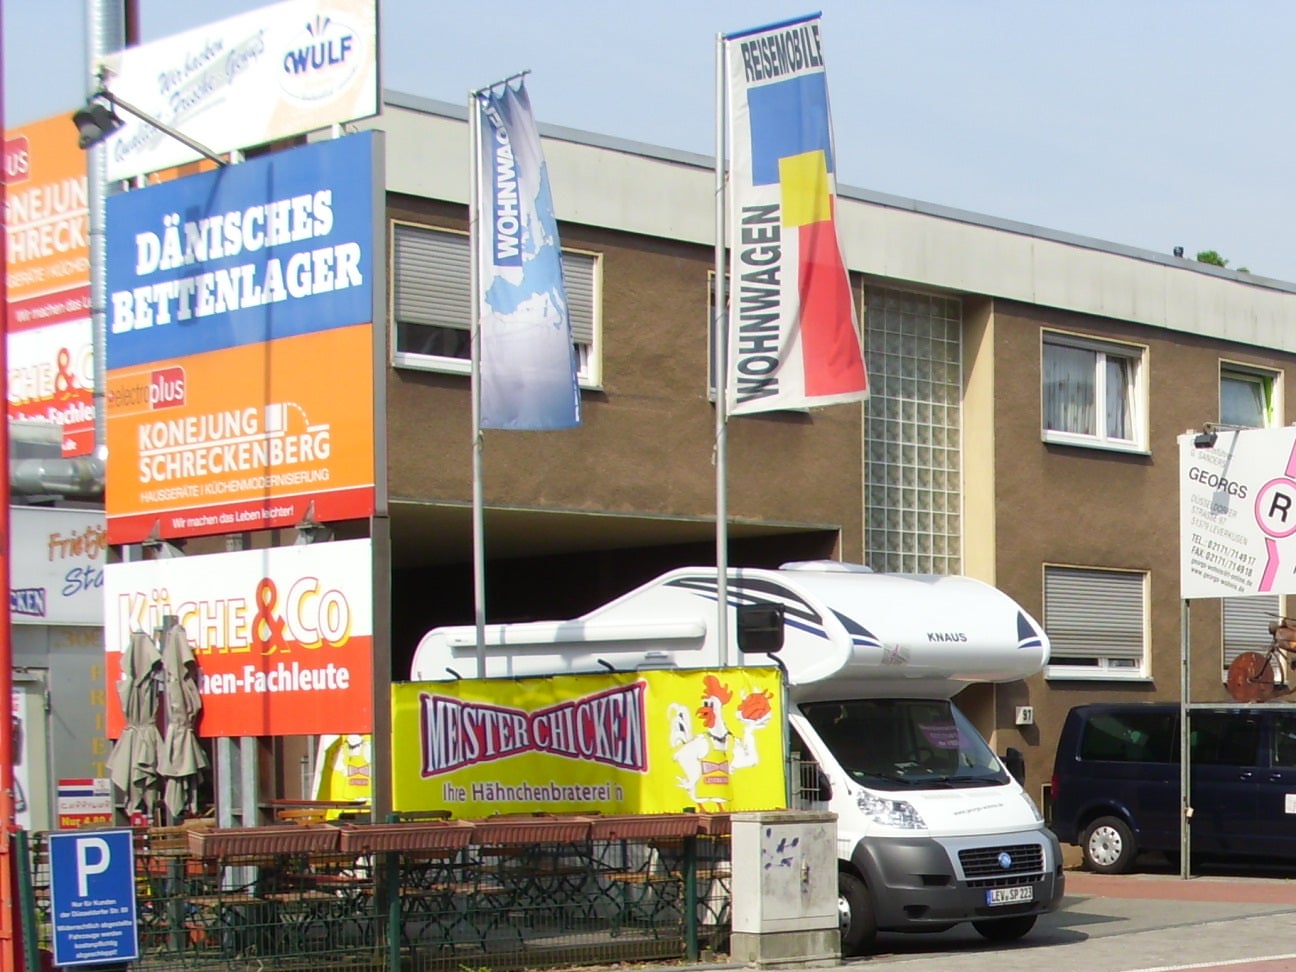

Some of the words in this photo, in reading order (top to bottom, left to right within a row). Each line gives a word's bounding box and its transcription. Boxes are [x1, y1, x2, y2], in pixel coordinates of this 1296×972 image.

[283, 35, 353, 75] WULF
[135, 189, 334, 276] DÄNISCHES
[111, 242, 363, 334] BETTENLAGER
[737, 203, 780, 404] WOHNWAGEN
[139, 407, 258, 450] KONEJUNG
[140, 431, 330, 483] SCHRECKENBERG
[1188, 467, 1248, 499] GEORGS
[172, 517, 185, 529] Wir
[187, 512, 218, 527] machen
[220, 510, 234, 524] das
[235, 507, 260, 523] Leben
[1268, 492, 1292, 523] R
[927, 632, 968, 642] KNAUS
[425, 698, 530, 772] MEISTER
[532, 687, 643, 767] CHICKEN
[472, 783, 610, 801] Hähnchenbraterei
[76, 837, 111, 897] P
